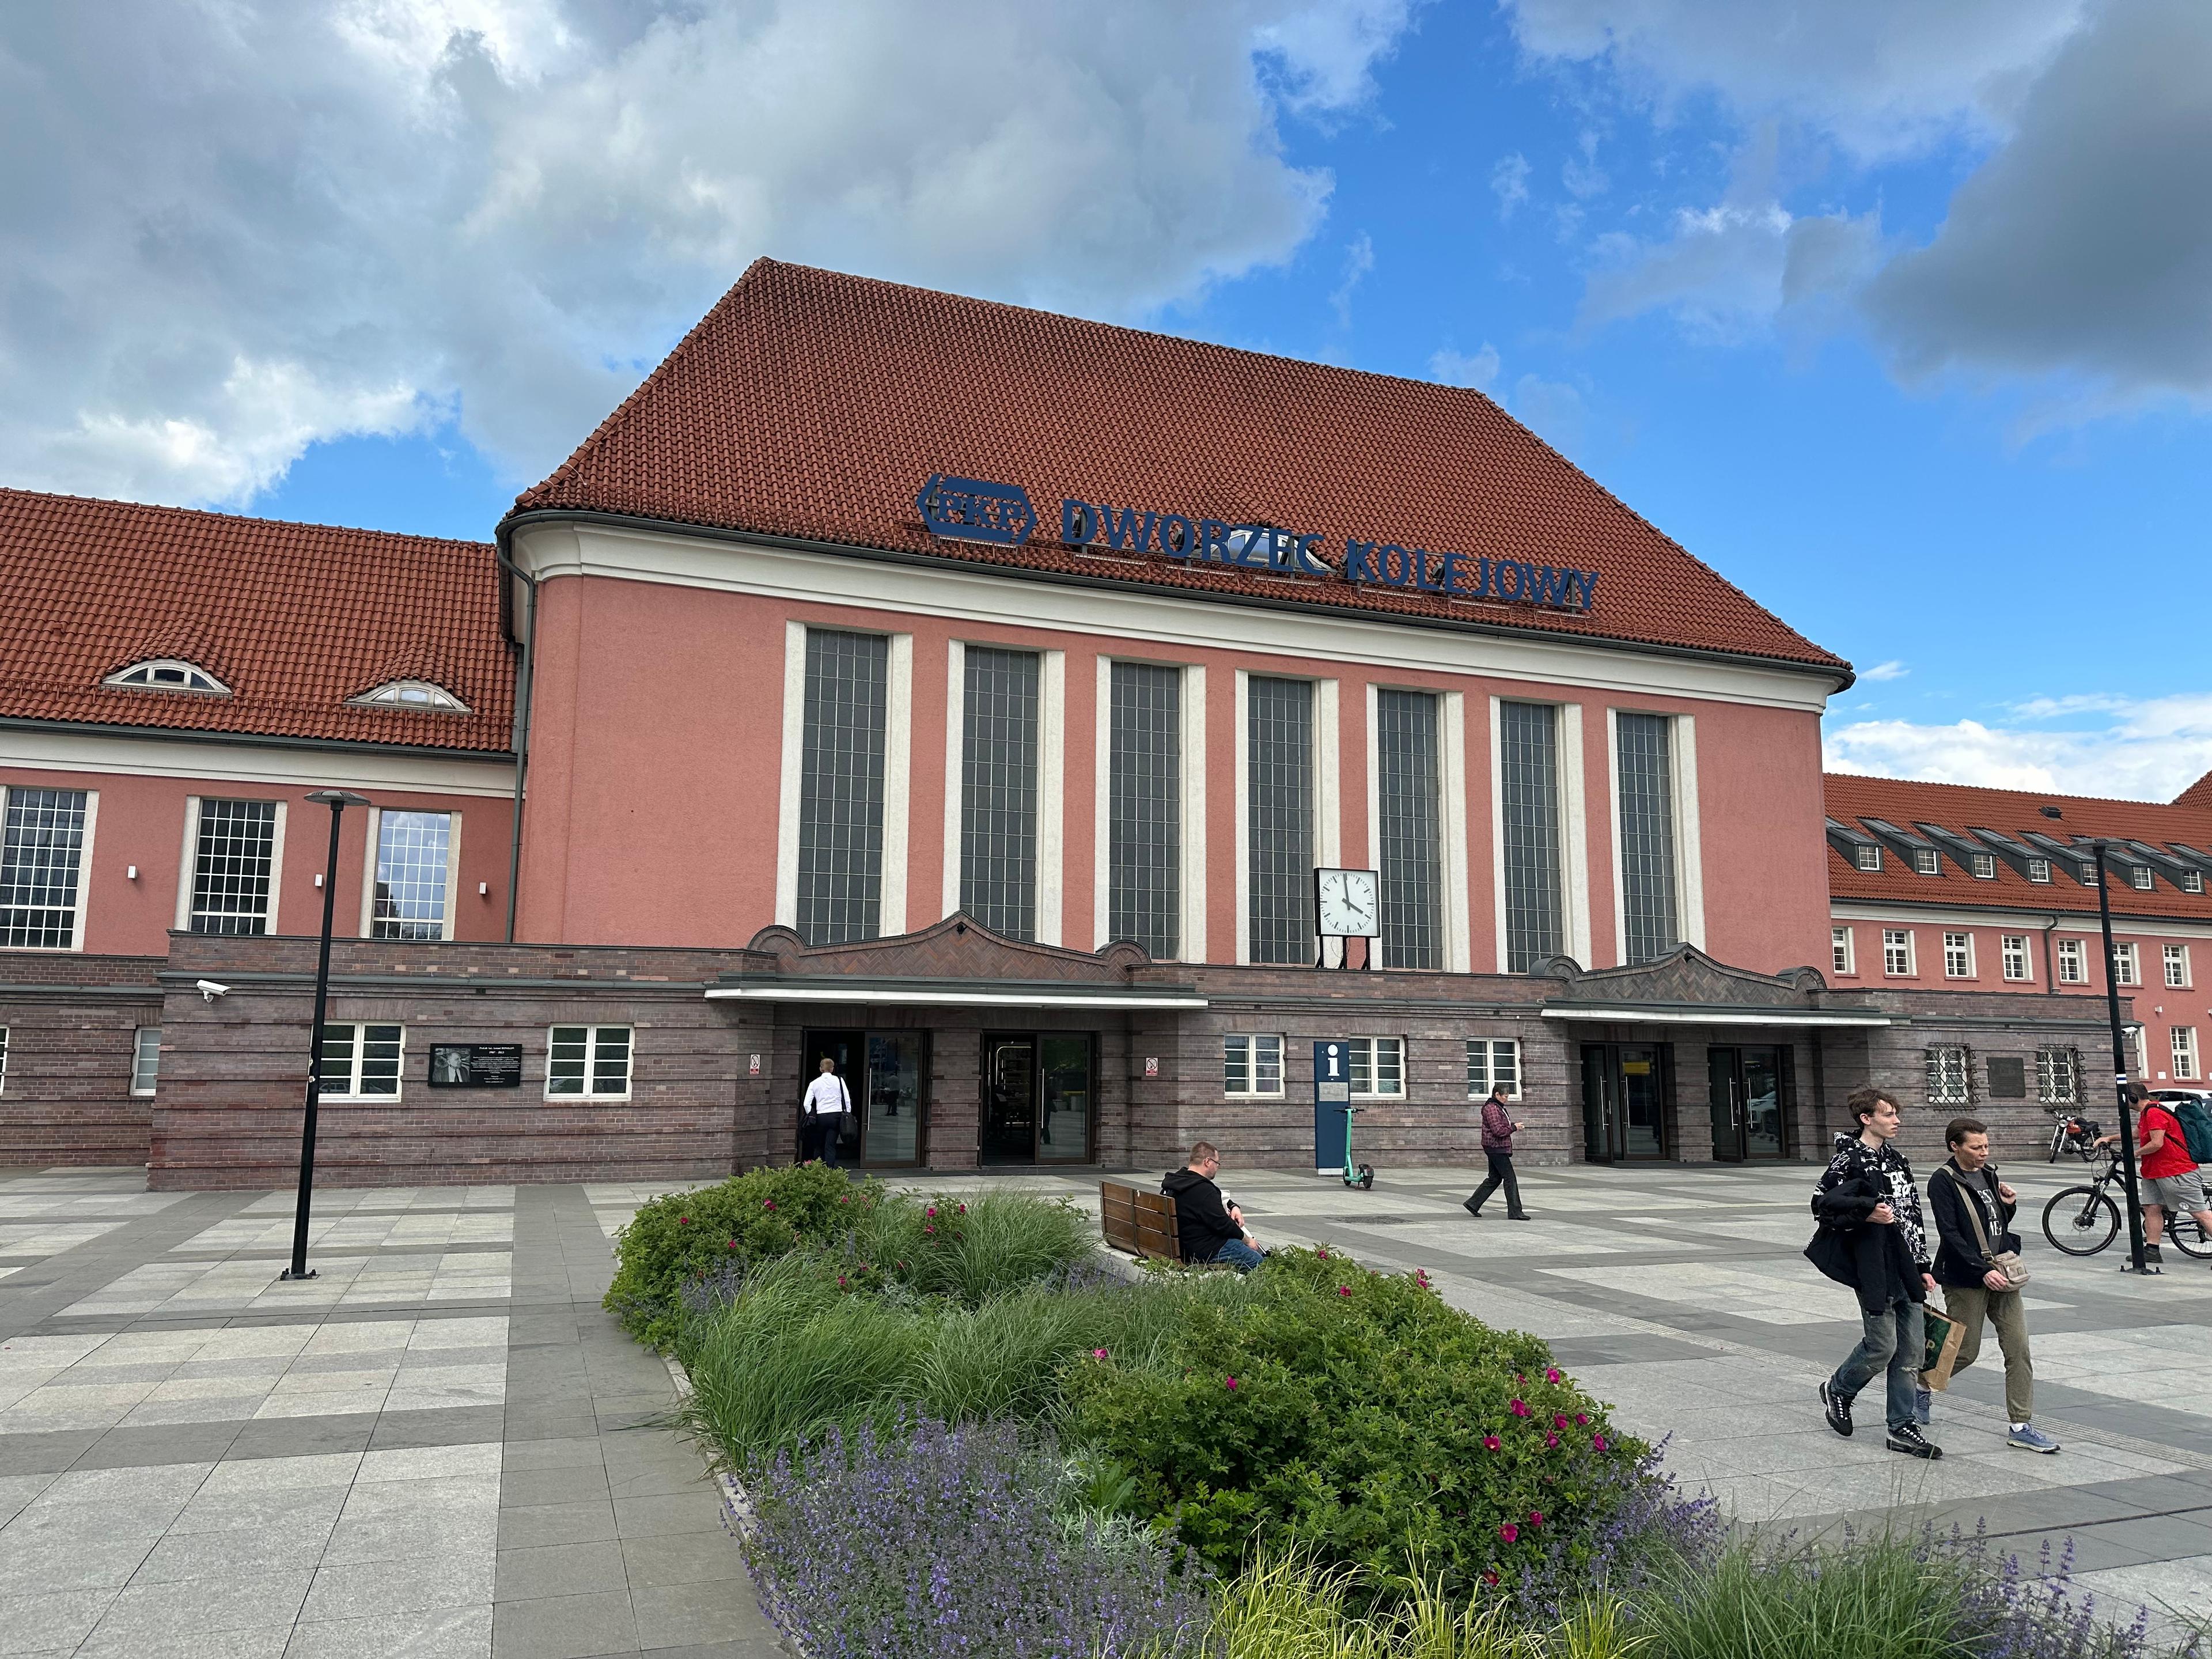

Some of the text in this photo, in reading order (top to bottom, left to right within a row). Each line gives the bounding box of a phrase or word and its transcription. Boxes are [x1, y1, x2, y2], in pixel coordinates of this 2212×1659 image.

[936, 493, 1022, 529] PKP
[1062, 499, 1600, 609] DWORZEC KOLEJOWY
